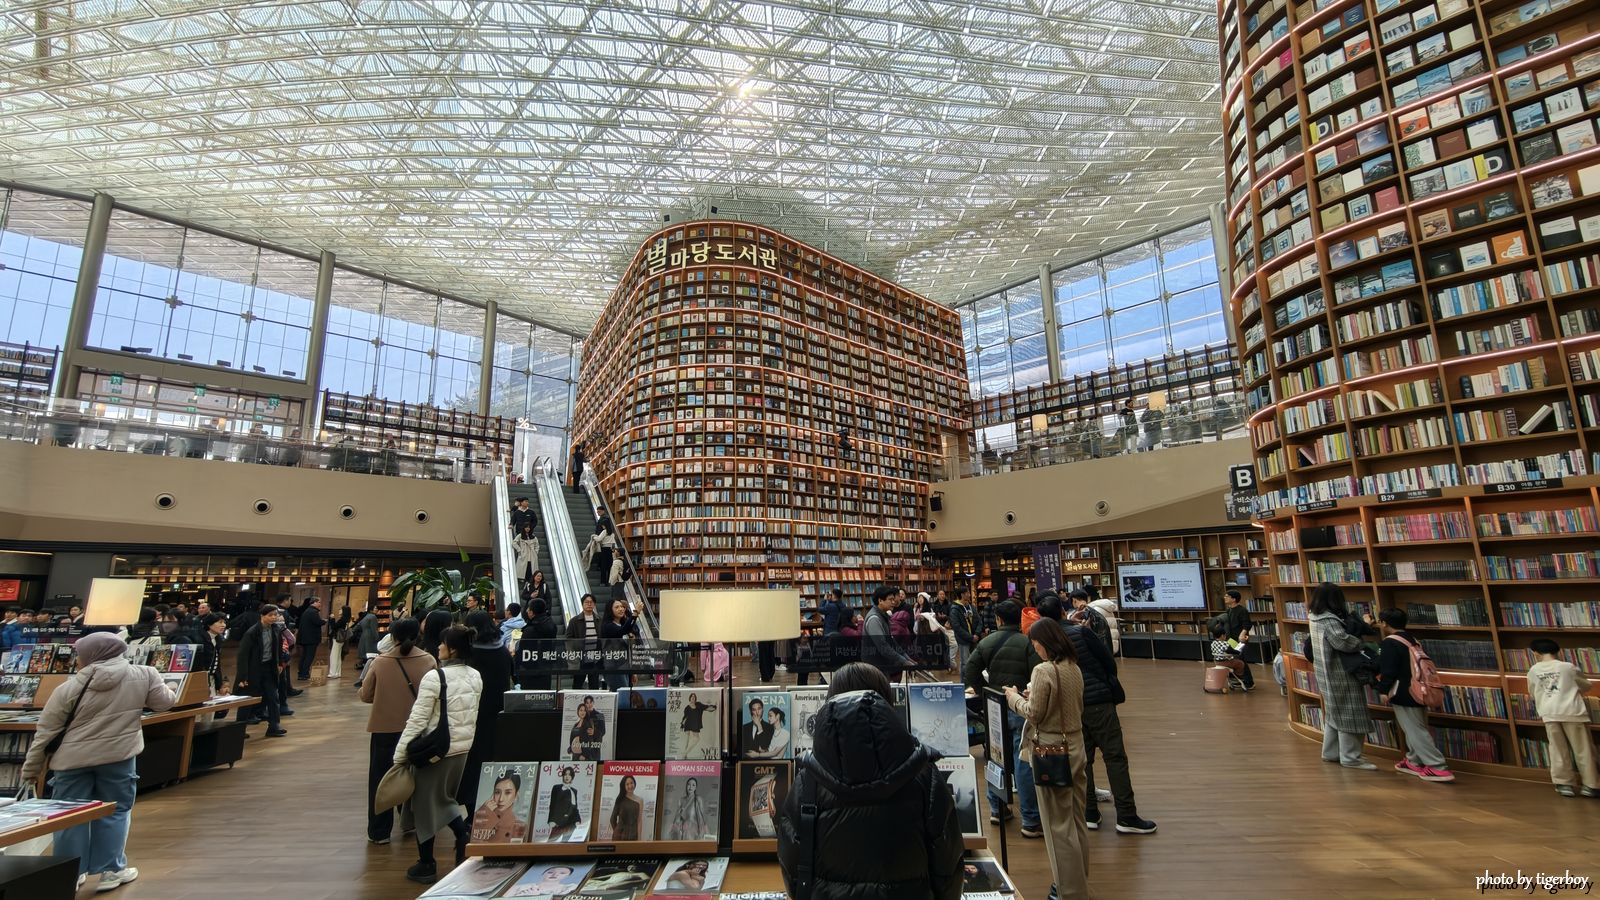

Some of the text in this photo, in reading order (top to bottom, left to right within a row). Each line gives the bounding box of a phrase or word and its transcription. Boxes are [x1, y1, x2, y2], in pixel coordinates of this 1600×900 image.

[1236, 469, 1252, 487] B
[1497, 484, 1516, 492] B30
[522, 649, 538, 662] D5
[922, 687, 953, 699] Gifts
[754, 766, 776, 775] GMT
